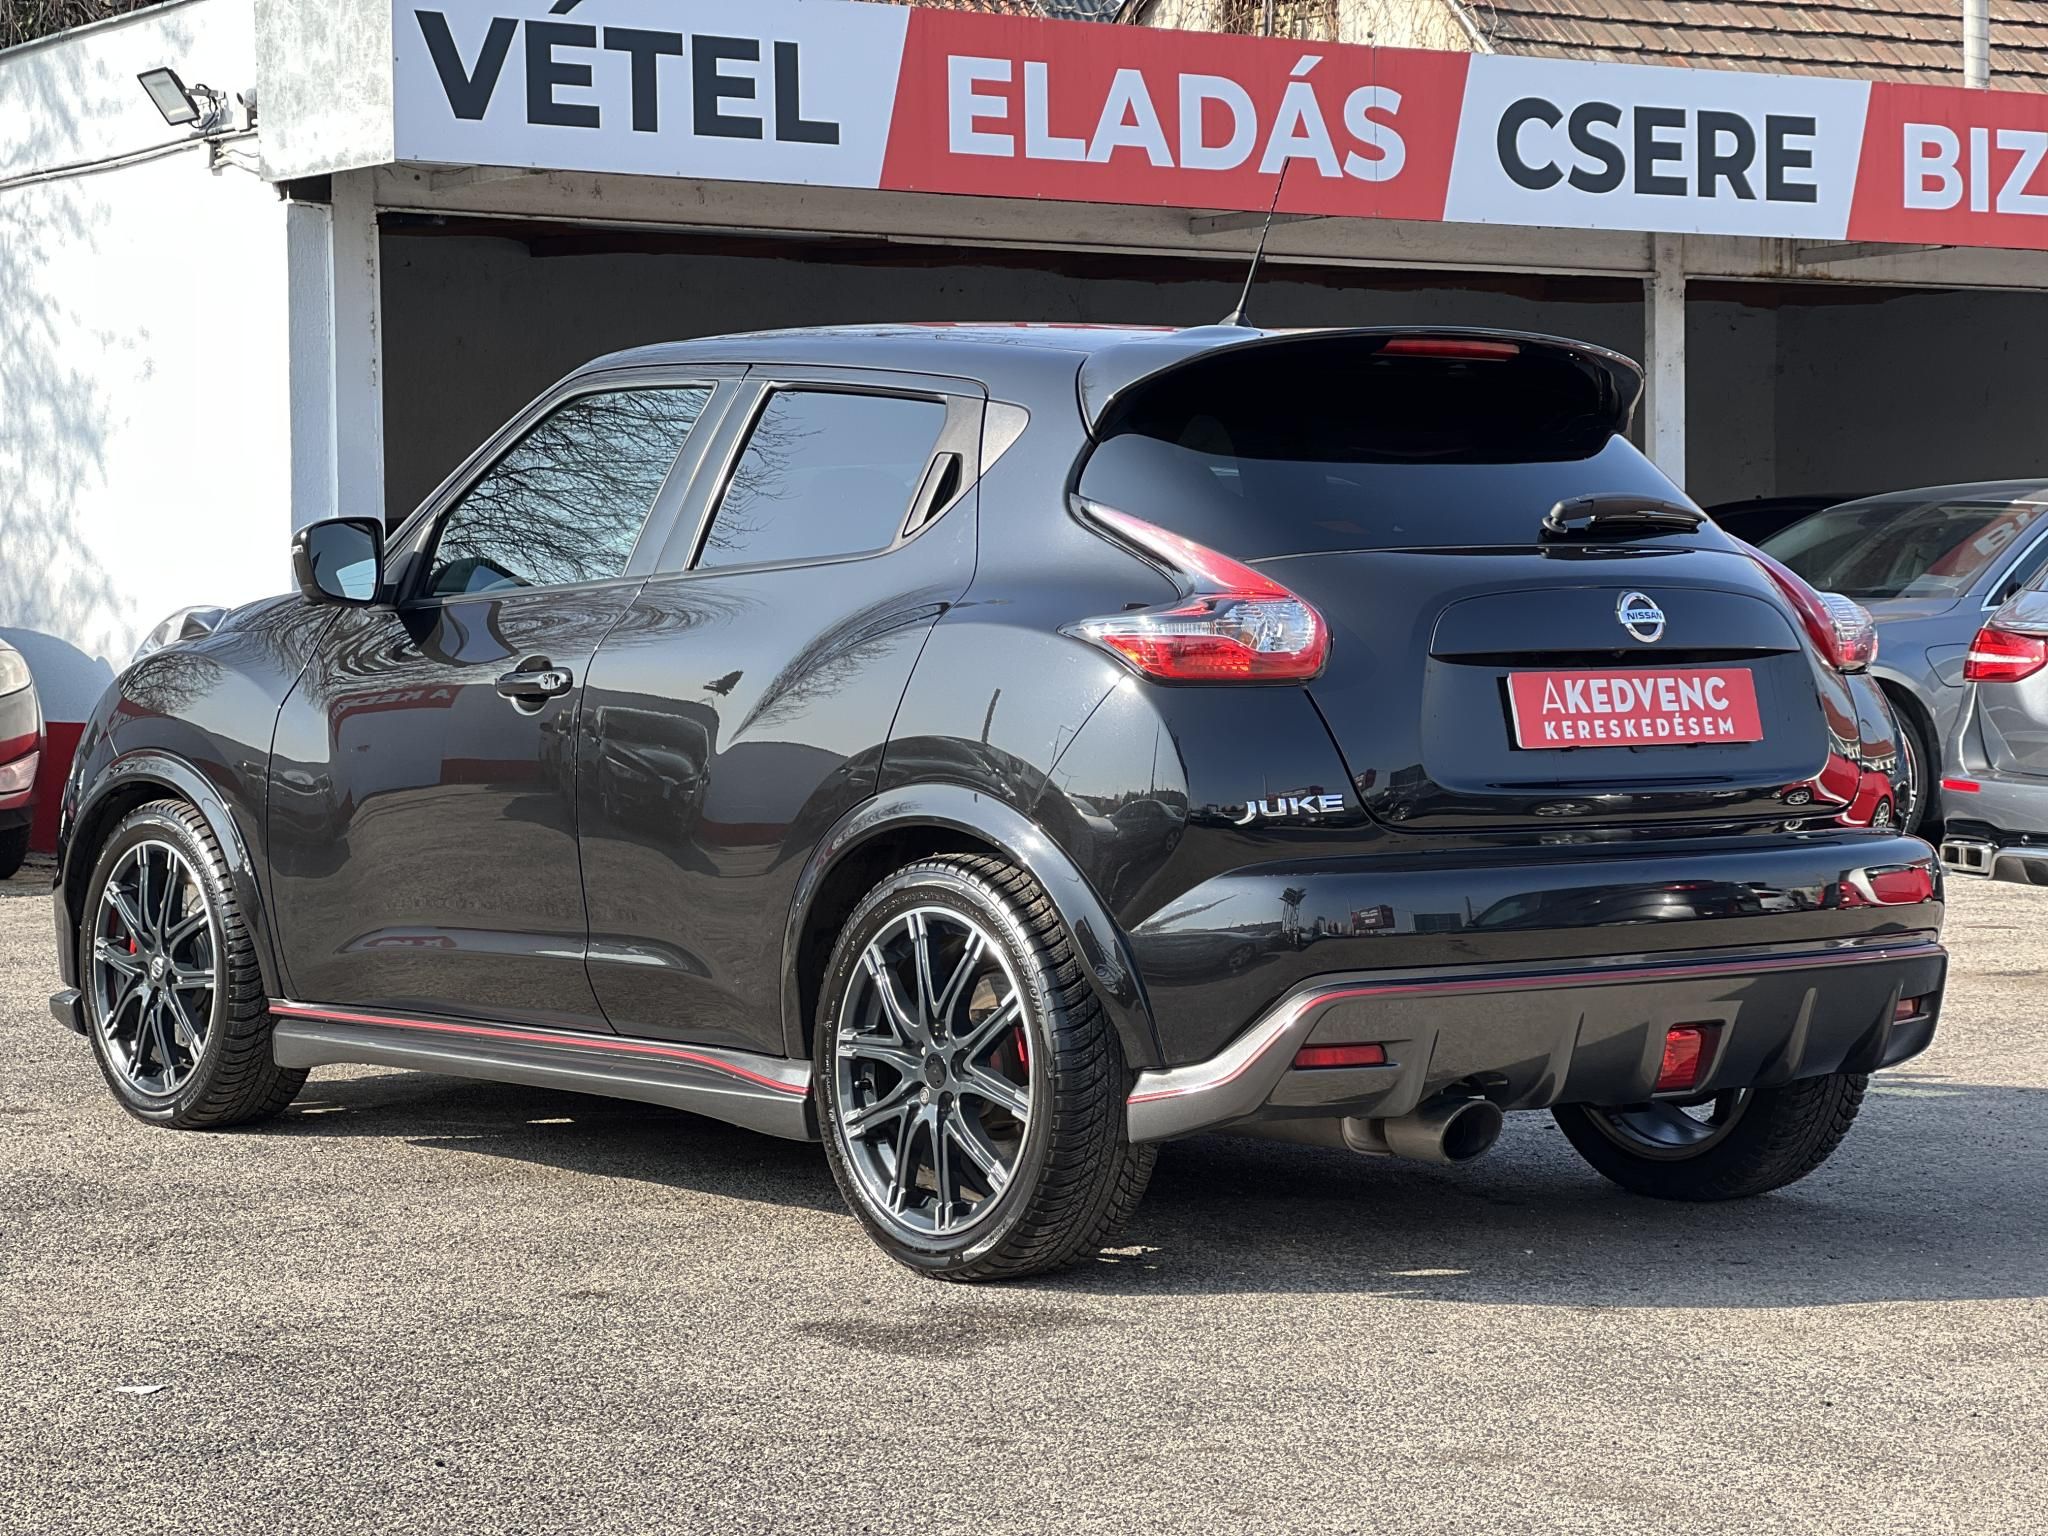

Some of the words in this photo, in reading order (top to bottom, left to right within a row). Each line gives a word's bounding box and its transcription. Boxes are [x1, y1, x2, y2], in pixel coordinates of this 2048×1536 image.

[414, 0, 840, 145] VÉTEL
[947, 54, 1406, 182] ELADÁS
[1496, 97, 1818, 204] CSERE
[1903, 122, 2048, 216] BIZ
[1626, 611, 1662, 621] NISSAN
[1543, 711, 1735, 740] KERESKEDÉSEM
[1234, 794, 1344, 825] JUKE
[986, 906, 1046, 1024] BRIDGESTONE
